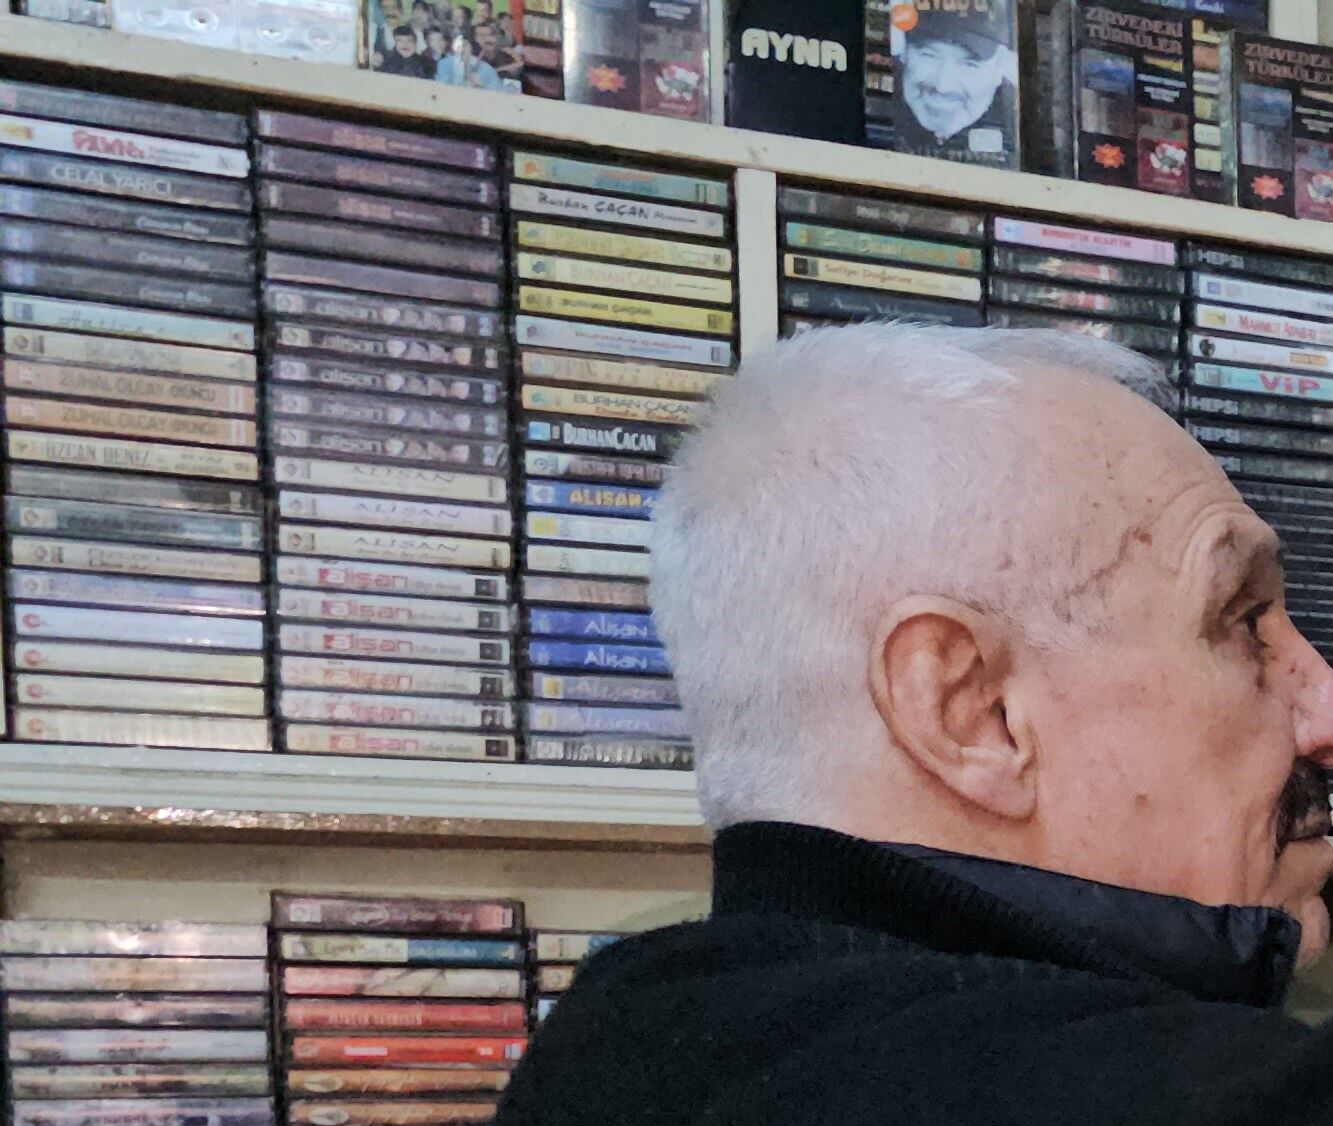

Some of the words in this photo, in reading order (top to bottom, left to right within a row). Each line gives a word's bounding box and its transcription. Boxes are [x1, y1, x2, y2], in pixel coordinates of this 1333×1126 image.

[741, 27, 848, 72] AYNA
[52, 165, 105, 184] CELAL
[573, 392, 641, 409] BURHAN
